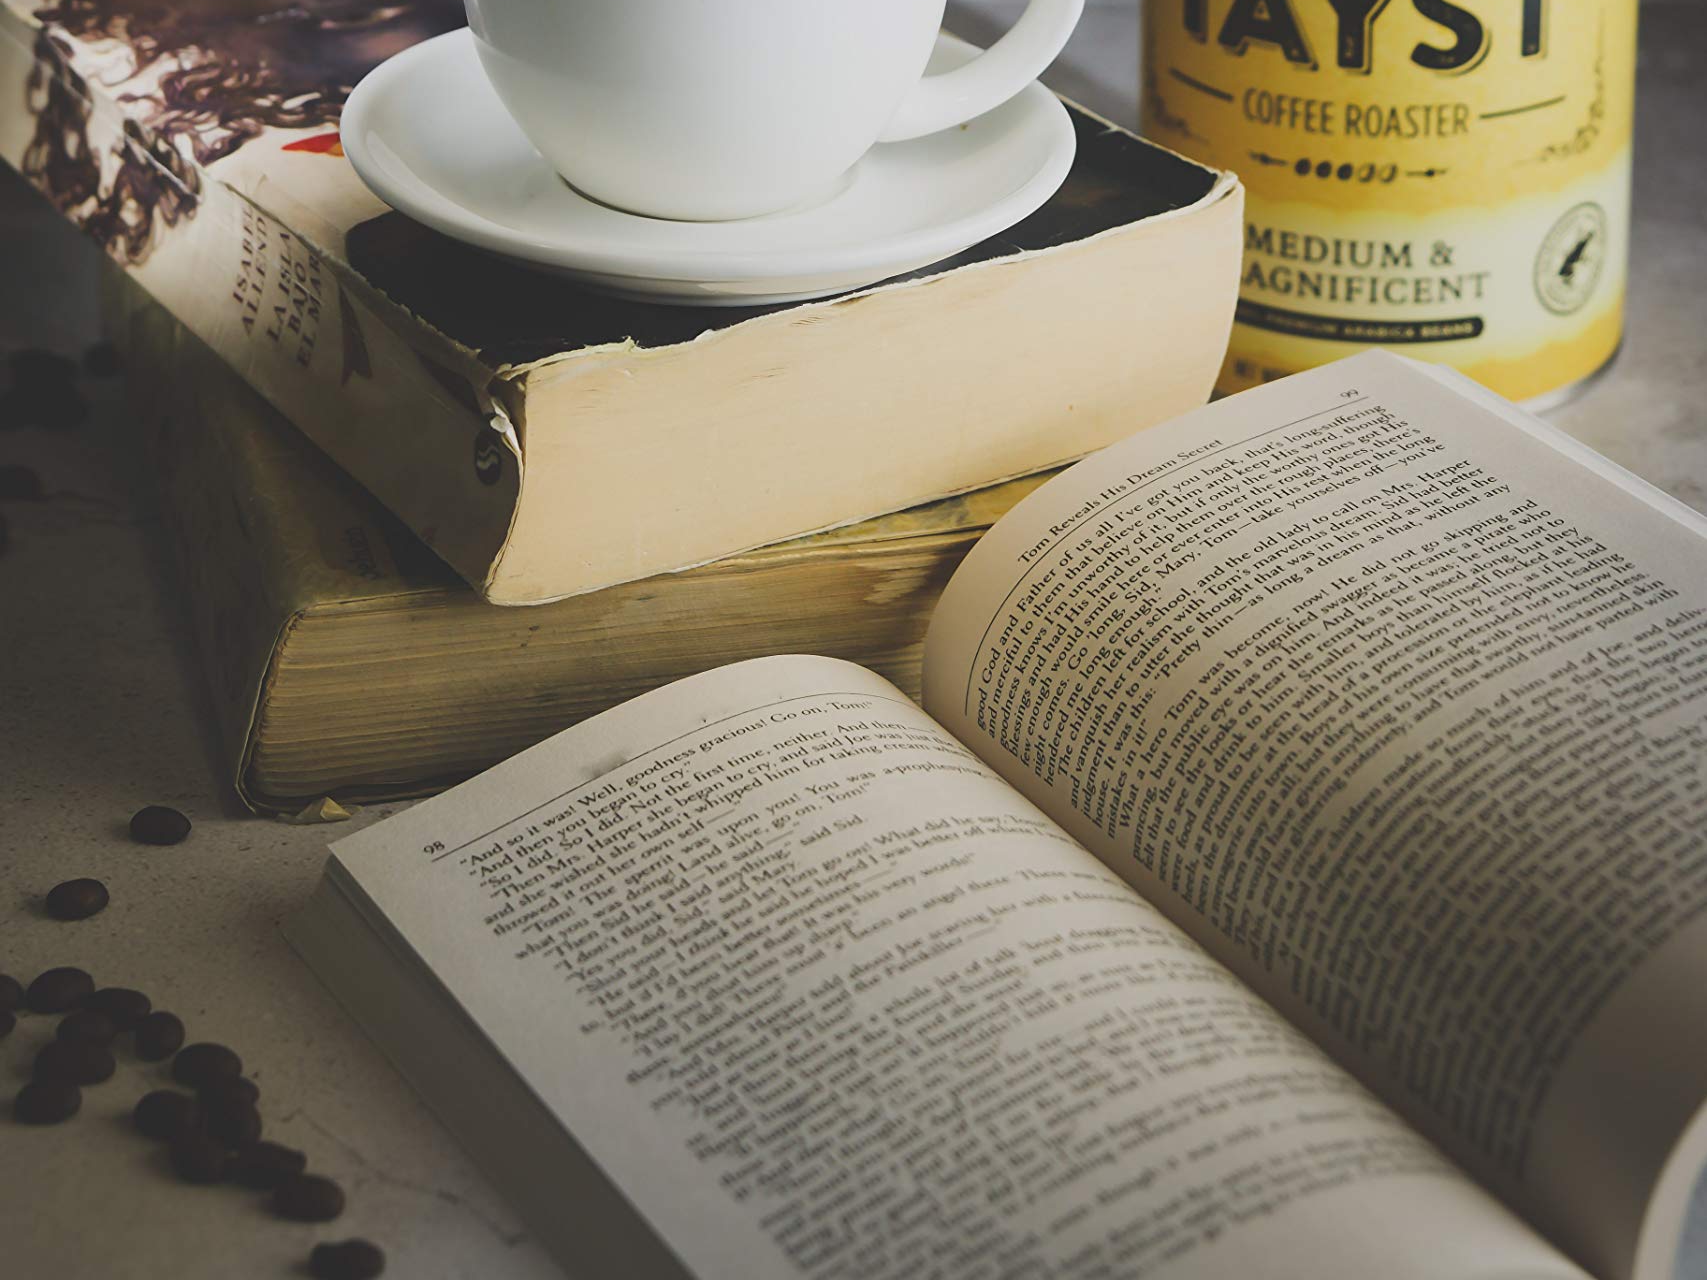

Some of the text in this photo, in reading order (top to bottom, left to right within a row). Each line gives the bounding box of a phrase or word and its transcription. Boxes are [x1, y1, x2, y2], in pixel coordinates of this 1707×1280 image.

[1242, 87, 1470, 139] COFFEE ROASTER
[1241, 260, 1491, 305] AGNIFICENT
[1245, 222, 1455, 269] MEDIUM &
[1340, 388, 1360, 399] 99
[977, 404, 1387, 731] good God and Father of us all I've got you back, that's long-suffering
[1017, 438, 1224, 565] Tom Reveals His Dream Secret
[987, 412, 1396, 739] and merciful to them that believe on Him and keep His word, though
[1000, 419, 1410, 752] goodness knows I'm unworthy of it, but if only the worthy ones got His
[1008, 427, 1422, 757] blessings and had His hand to help them over the rough places, there's
[1020, 434, 1437, 767] few enough would smile here or ever enter into His rest when the long
[1033, 734, 1047, 778] night
[1043, 677, 1070, 731] comes.
[1067, 646, 1089, 671] Go
[1124, 582, 1161, 604] Sid,
[1155, 551, 1202, 579] Mary,
[1286, 476, 1362, 510] yourselves
[483, 902, 515, 926] and
[518, 888, 547, 908] she
[549, 854, 607, 891] wished
[608, 839, 638, 860] she
[638, 809, 691, 844] hadn't
[694, 776, 765, 816] whipped
[766, 764, 801, 783] him
[802, 755, 828, 770] for
[831, 743, 883, 761] taking
[506, 833, 525, 847] so
[525, 825, 541, 837] it
[542, 804, 577, 827] was!
[577, 783, 624, 808] Well,
[625, 746, 697, 787] goodness
[698, 717, 768, 753] gracious!
[769, 711, 798, 723] Go
[801, 703, 828, 716] on,
[513, 863, 525, 876] I
[526, 850, 559, 870] did.
[559, 835, 584, 851] So
[584, 826, 595, 839] I
[598, 810, 630, 832] did.
[629, 792, 663, 815] Not
[664, 779, 692, 798] the
[693, 764, 725, 783] first
[727, 749, 772, 769] time,
[772, 728, 834, 751] neither.
[836, 720, 870, 734] And
[515, 835, 554, 858] then
[557, 818, 588, 840] you
[587, 790, 639, 820] began
[639, 780, 658, 793] to
[546, 853, 587, 875] Mrs.
[586, 819, 644, 855] Harper
[646, 803, 674, 822] she
[674, 778, 726, 808] began
[726, 771, 744, 784] to
[747, 759, 778, 777] cry,
[780, 747, 810, 763] and
[811, 736, 844, 753] said
[848, 732, 872, 745] Joe
[874, 731, 903, 740] was
[423, 840, 446, 856] 98
